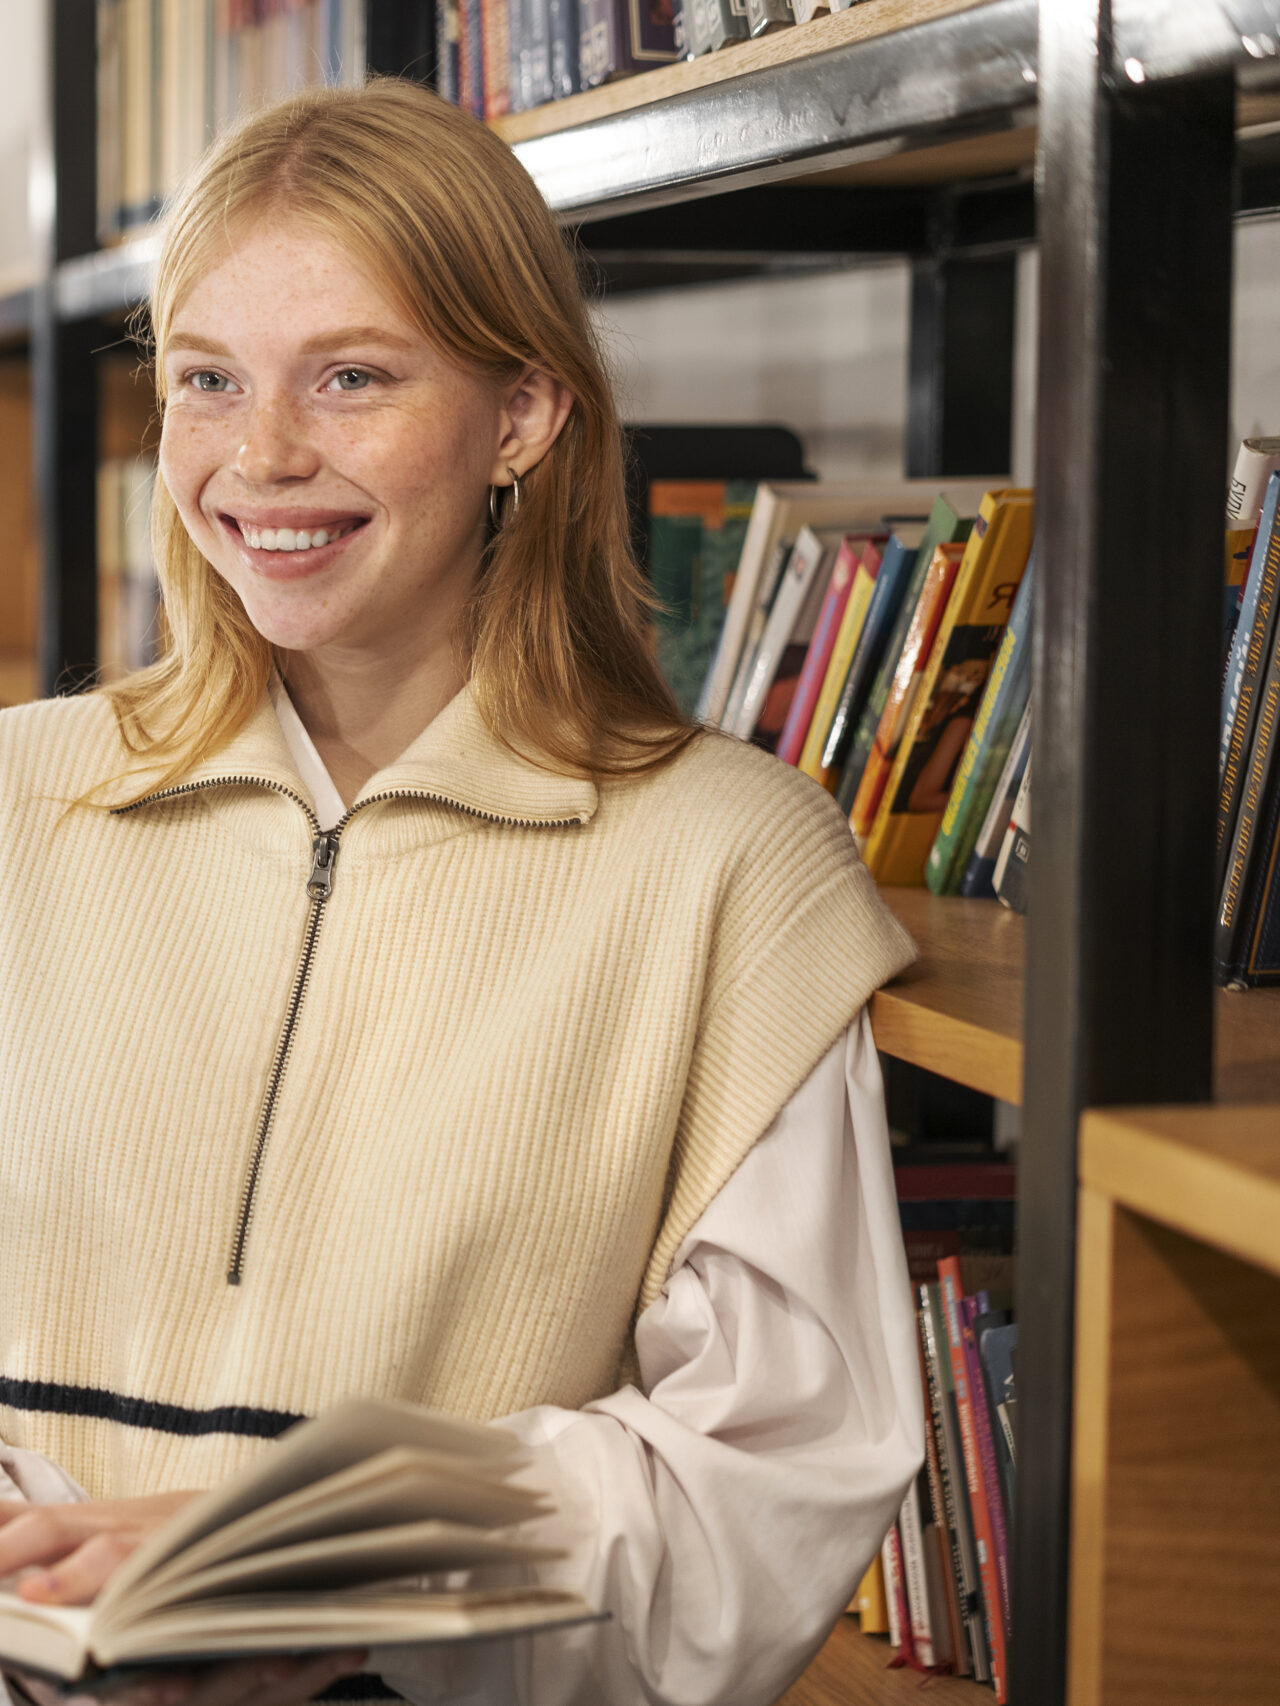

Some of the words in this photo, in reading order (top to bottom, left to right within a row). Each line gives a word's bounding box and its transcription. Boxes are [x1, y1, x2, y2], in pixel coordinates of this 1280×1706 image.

[1220, 684, 1253, 814] ВЕЛИЧАЙШИХ
[1246, 532, 1280, 679] ЗАБЛУЖДЕНИЙ
[1221, 815, 1252, 928] КОЛЛЕКЦИЯ
[1246, 680, 1280, 812] ВЕЛИЧАЙШИХ
